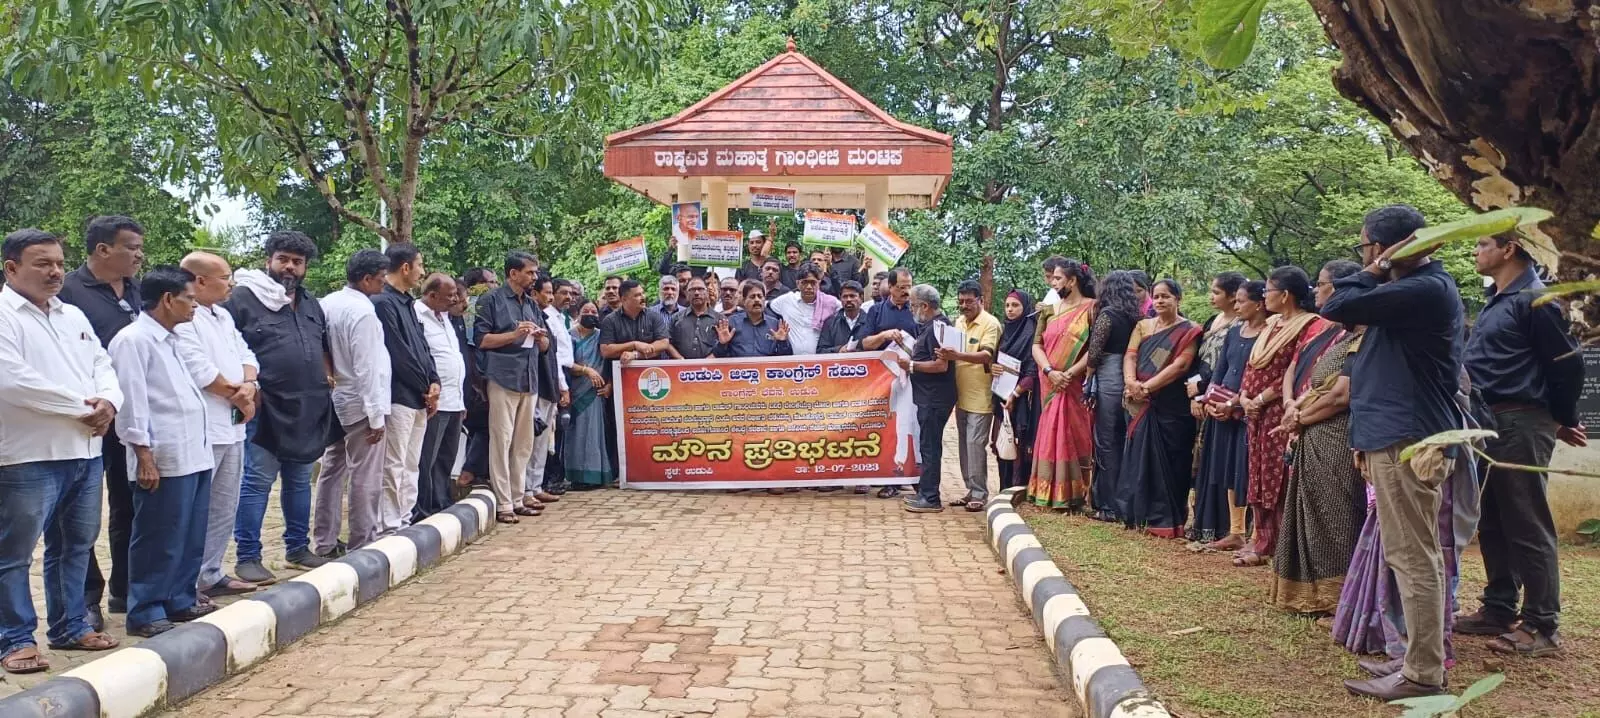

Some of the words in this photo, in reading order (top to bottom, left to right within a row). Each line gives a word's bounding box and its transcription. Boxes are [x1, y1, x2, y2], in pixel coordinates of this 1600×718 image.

[716, 148, 769, 172] ಮಹಾತ್ಮ
[775, 149, 840, 168] ಗಾಂಧೀಜಿ
[847, 147, 903, 166] ಮಂಟಪ
[679, 368, 722, 382] ಉಡುಪಿ
[730, 368, 760, 384] ಜಿಲ್ಲಾ
[766, 364, 822, 382] ಕಾಂಗ್ರೆಸ್
[828, 363, 868, 378] ಸಮಿತಿ
[789, 387, 819, 396] ಉಡುಪಿ
[652, 438, 733, 462] ಮೌನ
[743, 432, 881, 469] ಪ್ರತಿಭಟನೆ
[685, 467, 713, 475] ಉಡುಪಿ
[814, 463, 880, 473] 12-07-2023
